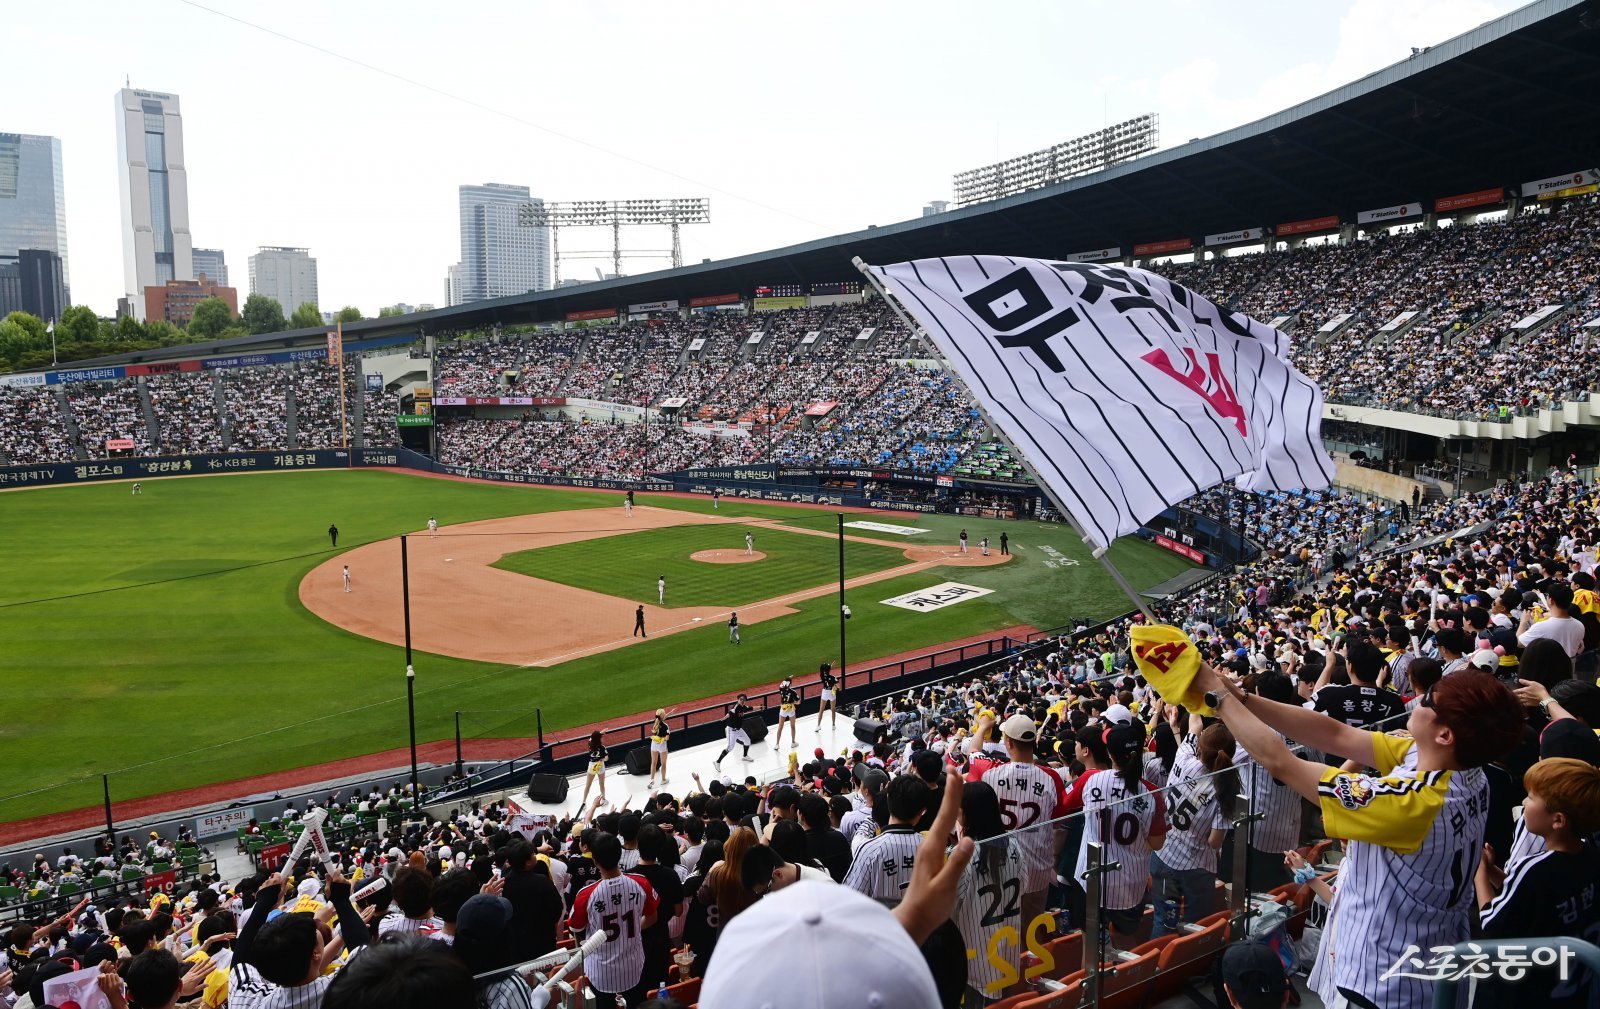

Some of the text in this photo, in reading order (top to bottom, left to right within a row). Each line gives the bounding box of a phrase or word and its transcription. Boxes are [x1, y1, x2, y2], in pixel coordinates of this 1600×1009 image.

[290, 350, 327, 361] 두산테스나
[8, 375, 43, 385] 두산퓨얼셀
[57, 369, 115, 382] 두산에너빌리티
[274, 455, 316, 466] 키움증권
[363, 456, 387, 465] 주식창
[0, 470, 55, 483] 한국경제TV
[734, 469, 775, 480] 충남혁신도시
[1342, 699, 1392, 717] 홍창기
[997, 778, 1045, 797] 이재원
[204, 810, 246, 826] 타구주의!
[999, 798, 1041, 831] 52
[1095, 808, 1140, 846] 10
[309, 828, 325, 854] TWINS
[577, 866, 597, 876] 문성
[883, 855, 914, 877] 문보
[354, 886, 377, 901] TWINS
[594, 892, 640, 913] 홍창기
[977, 877, 1021, 927] 22
[602, 909, 636, 942] 51
